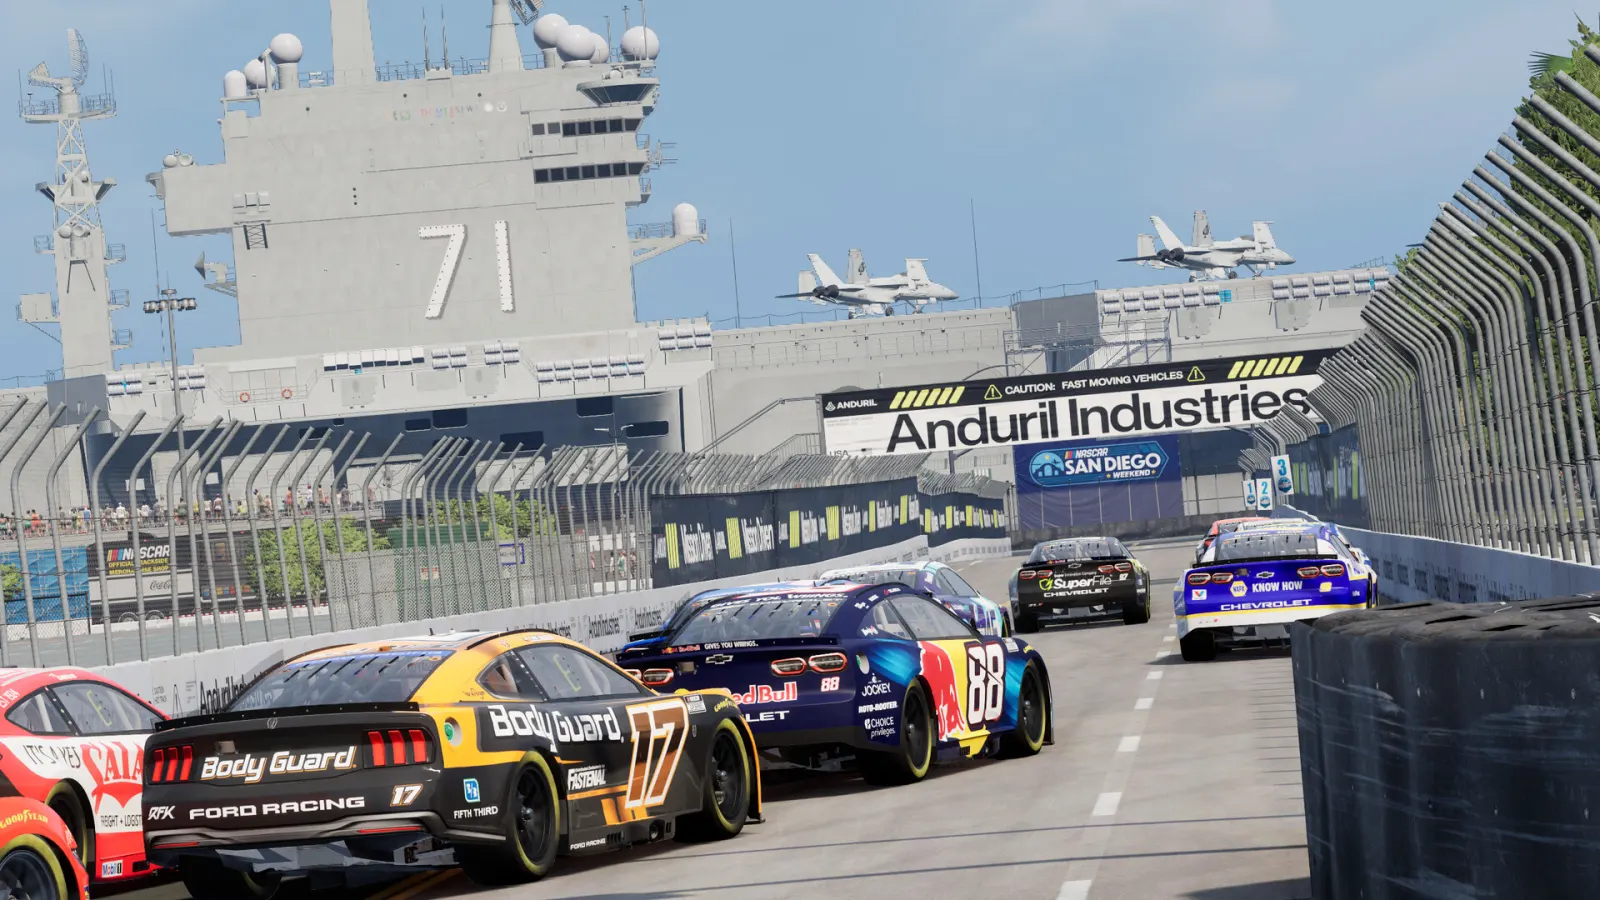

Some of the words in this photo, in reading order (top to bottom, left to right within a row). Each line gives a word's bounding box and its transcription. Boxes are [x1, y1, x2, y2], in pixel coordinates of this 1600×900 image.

[418, 219, 515, 319] 71
[1005, 382, 1056, 395] CAUTION:
[1061, 379, 1087, 390] FAST
[1089, 375, 1131, 387] MOVING
[1132, 371, 1184, 384] VEHICLES
[837, 399, 878, 410] ANDURIL
[886, 401, 1059, 453] Anduril
[1069, 384, 1311, 436] Industries
[1075, 447, 1109, 459] NASCAR
[1065, 458, 1101, 476] SAN
[1104, 452, 1162, 471] DIEGO
[1277, 459, 1288, 477] 3
[1113, 469, 1151, 479] WEEKEND
[1247, 482, 1253, 494] 1
[1261, 481, 1269, 495] 2
[122, 544, 170, 560] NSCAR
[1043, 588, 1109, 598] CHEVROLET
[1252, 581, 1280, 593] KNOW
[1282, 580, 1303, 591] HOW
[1220, 598, 1313, 611] CHEVROLET
[704, 642, 721, 650] GIVES
[721, 641, 733, 649] YOU
[820, 676, 840, 692] 88
[861, 682, 891, 697] JOCKEY
[966, 642, 1005, 729] 88
[732, 685, 757, 705] ed
[858, 700, 898, 714] ROTO-ROOTER
[487, 704, 558, 753] Body
[870, 717, 895, 728] CHOICE
[625, 698, 689, 809] 17
[200, 753, 267, 784] Body
[567, 768, 607, 791] FASTENAL
[390, 784, 424, 807] 17
[189, 804, 257, 820] FORD
[262, 797, 365, 815] RACING
[454, 809, 473, 820] FIFTH
[474, 805, 499, 817] THIRD
[570, 843, 586, 851] FORD
[586, 837, 606, 847] RACING
[102, 863, 117, 876] Mobil
